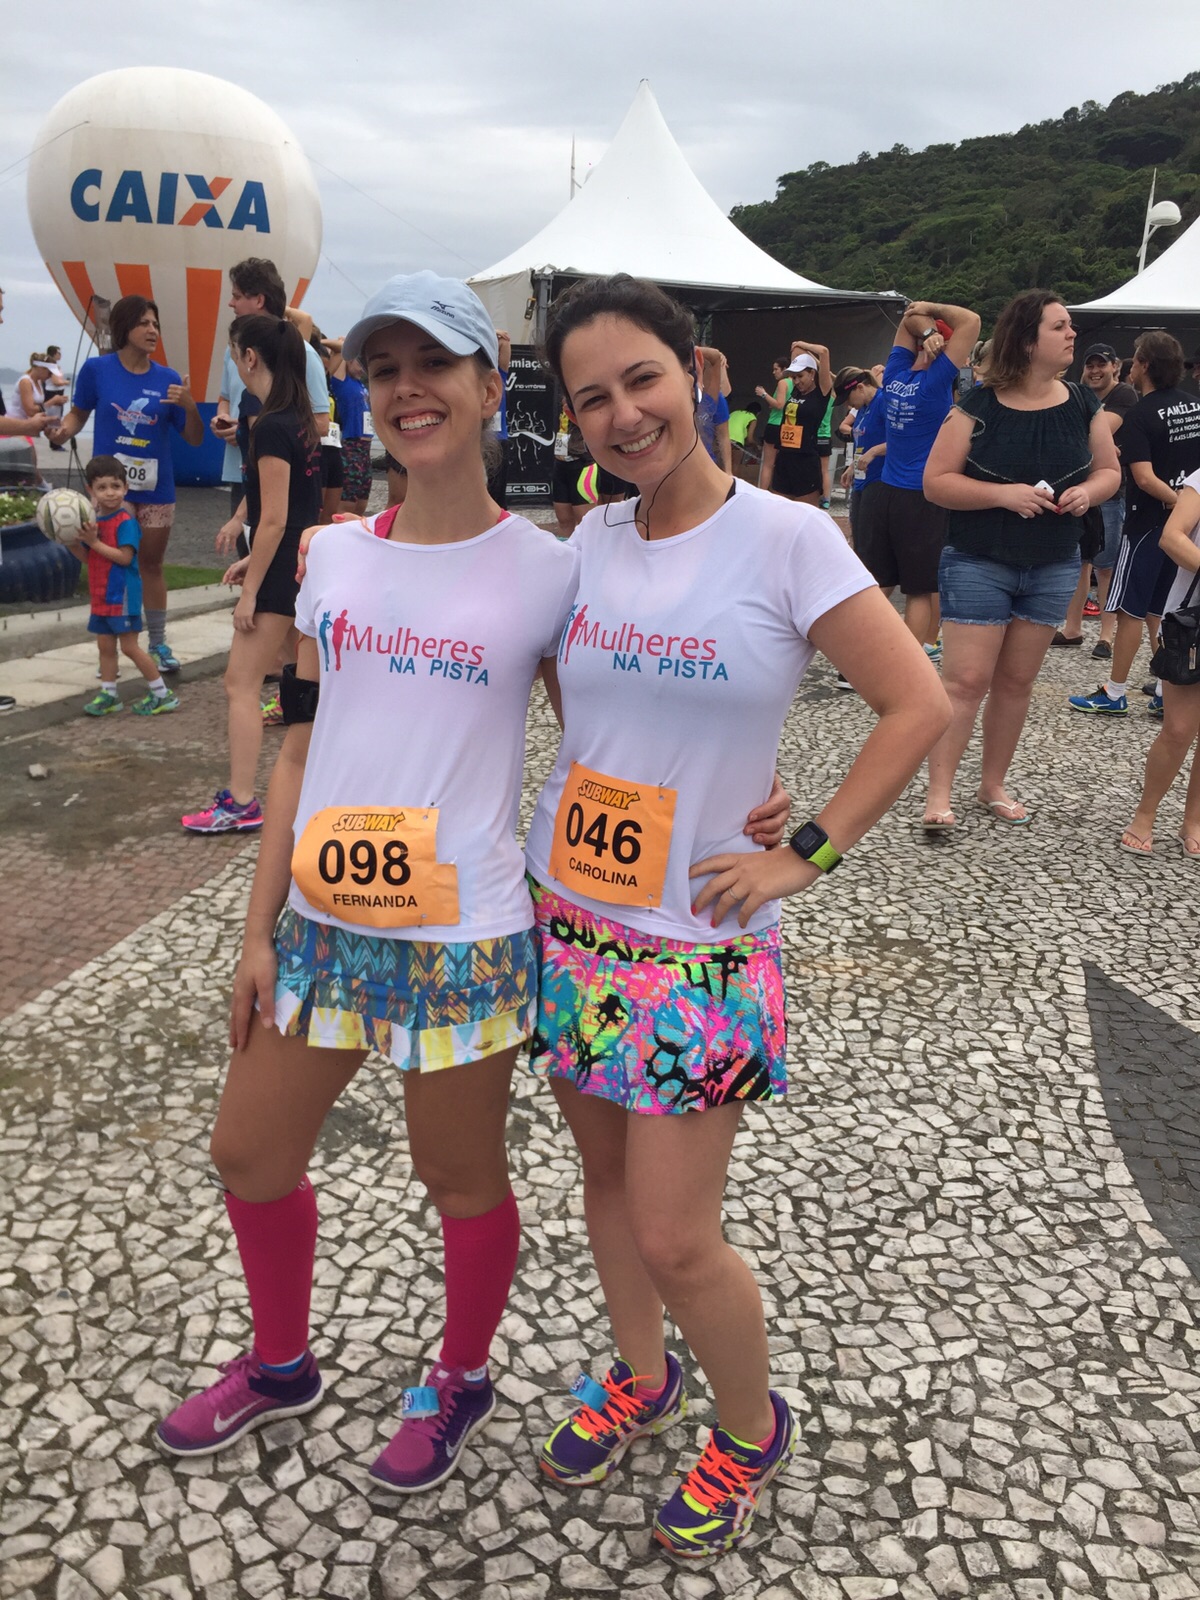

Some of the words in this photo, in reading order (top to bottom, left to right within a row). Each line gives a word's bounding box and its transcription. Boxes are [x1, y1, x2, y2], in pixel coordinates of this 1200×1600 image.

[70, 168, 271, 234] CAIXA
[346, 624, 485, 666] Mulheres
[576, 620, 717, 661] Mulheres
[389, 656, 416, 675] NA
[429, 659, 489, 687] PISTA
[613, 652, 642, 673] NA
[658, 657, 729, 682] PISTA
[578, 779, 641, 811] SUBWAY
[332, 812, 406, 833] SUBWAY
[566, 802, 643, 865] 046
[318, 839, 411, 886] 098
[569, 857, 638, 888] CAROLINA
[333, 893, 418, 908] FERNANDA
